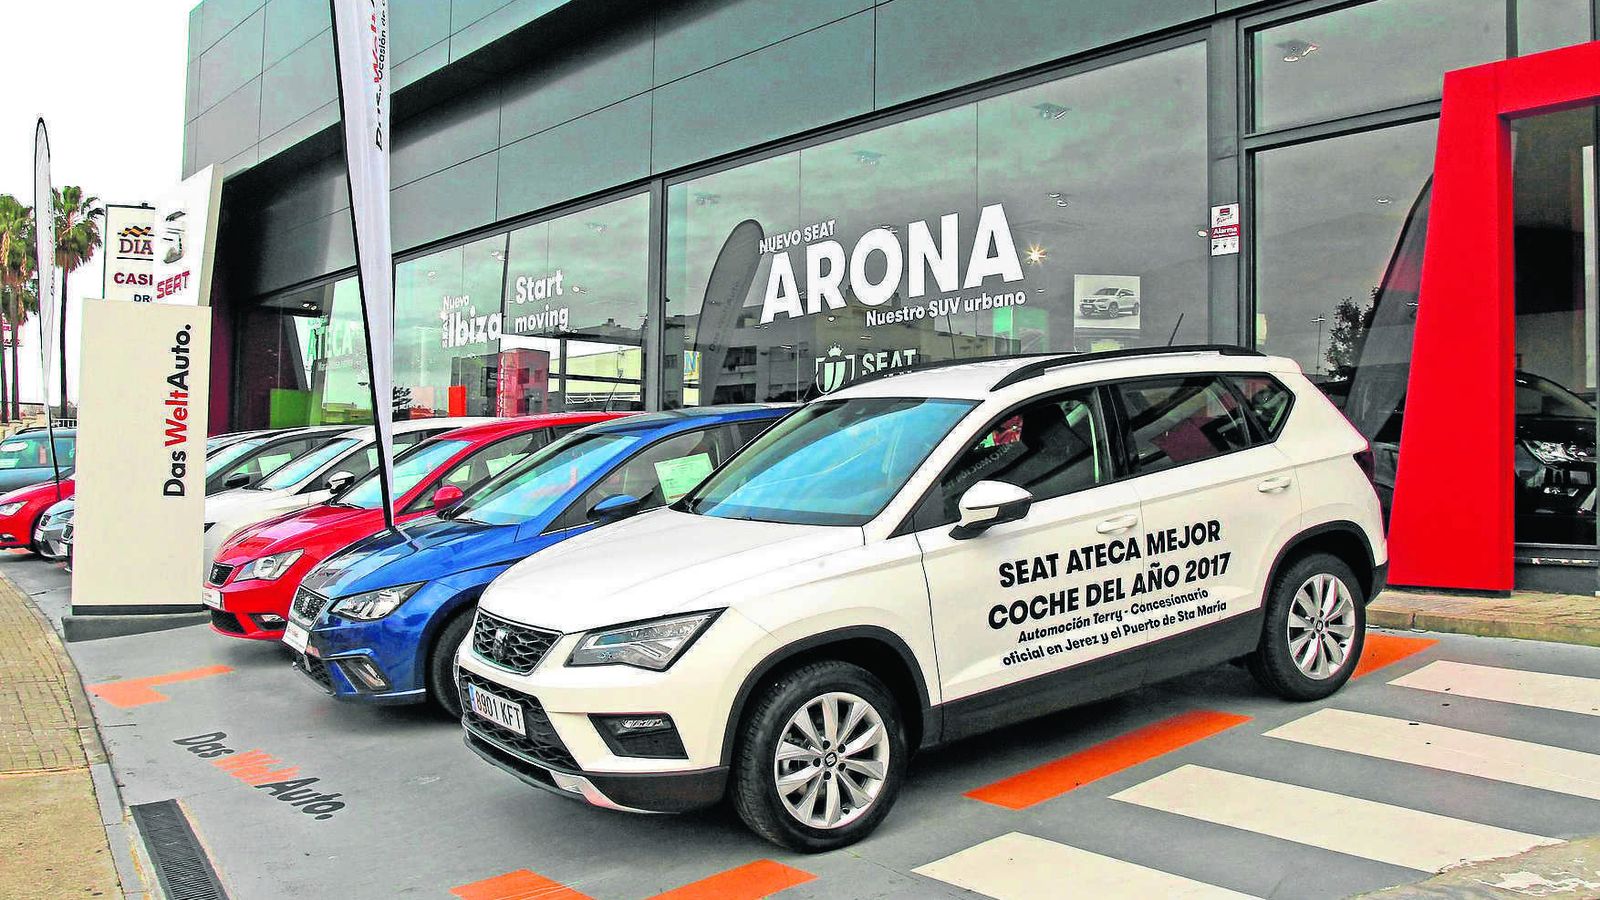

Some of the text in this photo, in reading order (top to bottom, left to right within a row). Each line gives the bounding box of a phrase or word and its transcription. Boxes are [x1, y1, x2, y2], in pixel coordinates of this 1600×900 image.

[759, 220, 835, 254] NUEVO SEAT
[760, 203, 1024, 325] ARONA
[443, 295, 470, 311] Nuevo
[516, 270, 563, 304] Start
[448, 305, 503, 348] Ibiza
[515, 304, 569, 333] moving
[866, 291, 1026, 327] Nuestro SUV urbano
[861, 349, 916, 376] SEAT
[163, 450, 187, 496] Das
[999, 519, 1220, 588] SEAT ATECA MEJOR
[988, 552, 1231, 629] COCHE DEL AÑO 2017
[1003, 600, 1227, 665] oficial en Jerez y el Puerto de Sta María
[1018, 616, 1090, 643] Automoción
[1093, 609, 1123, 625] Terry
[1131, 588, 1209, 615] Concesionario
[500, 701, 521, 730] KFT
[173, 731, 235, 759] Das
